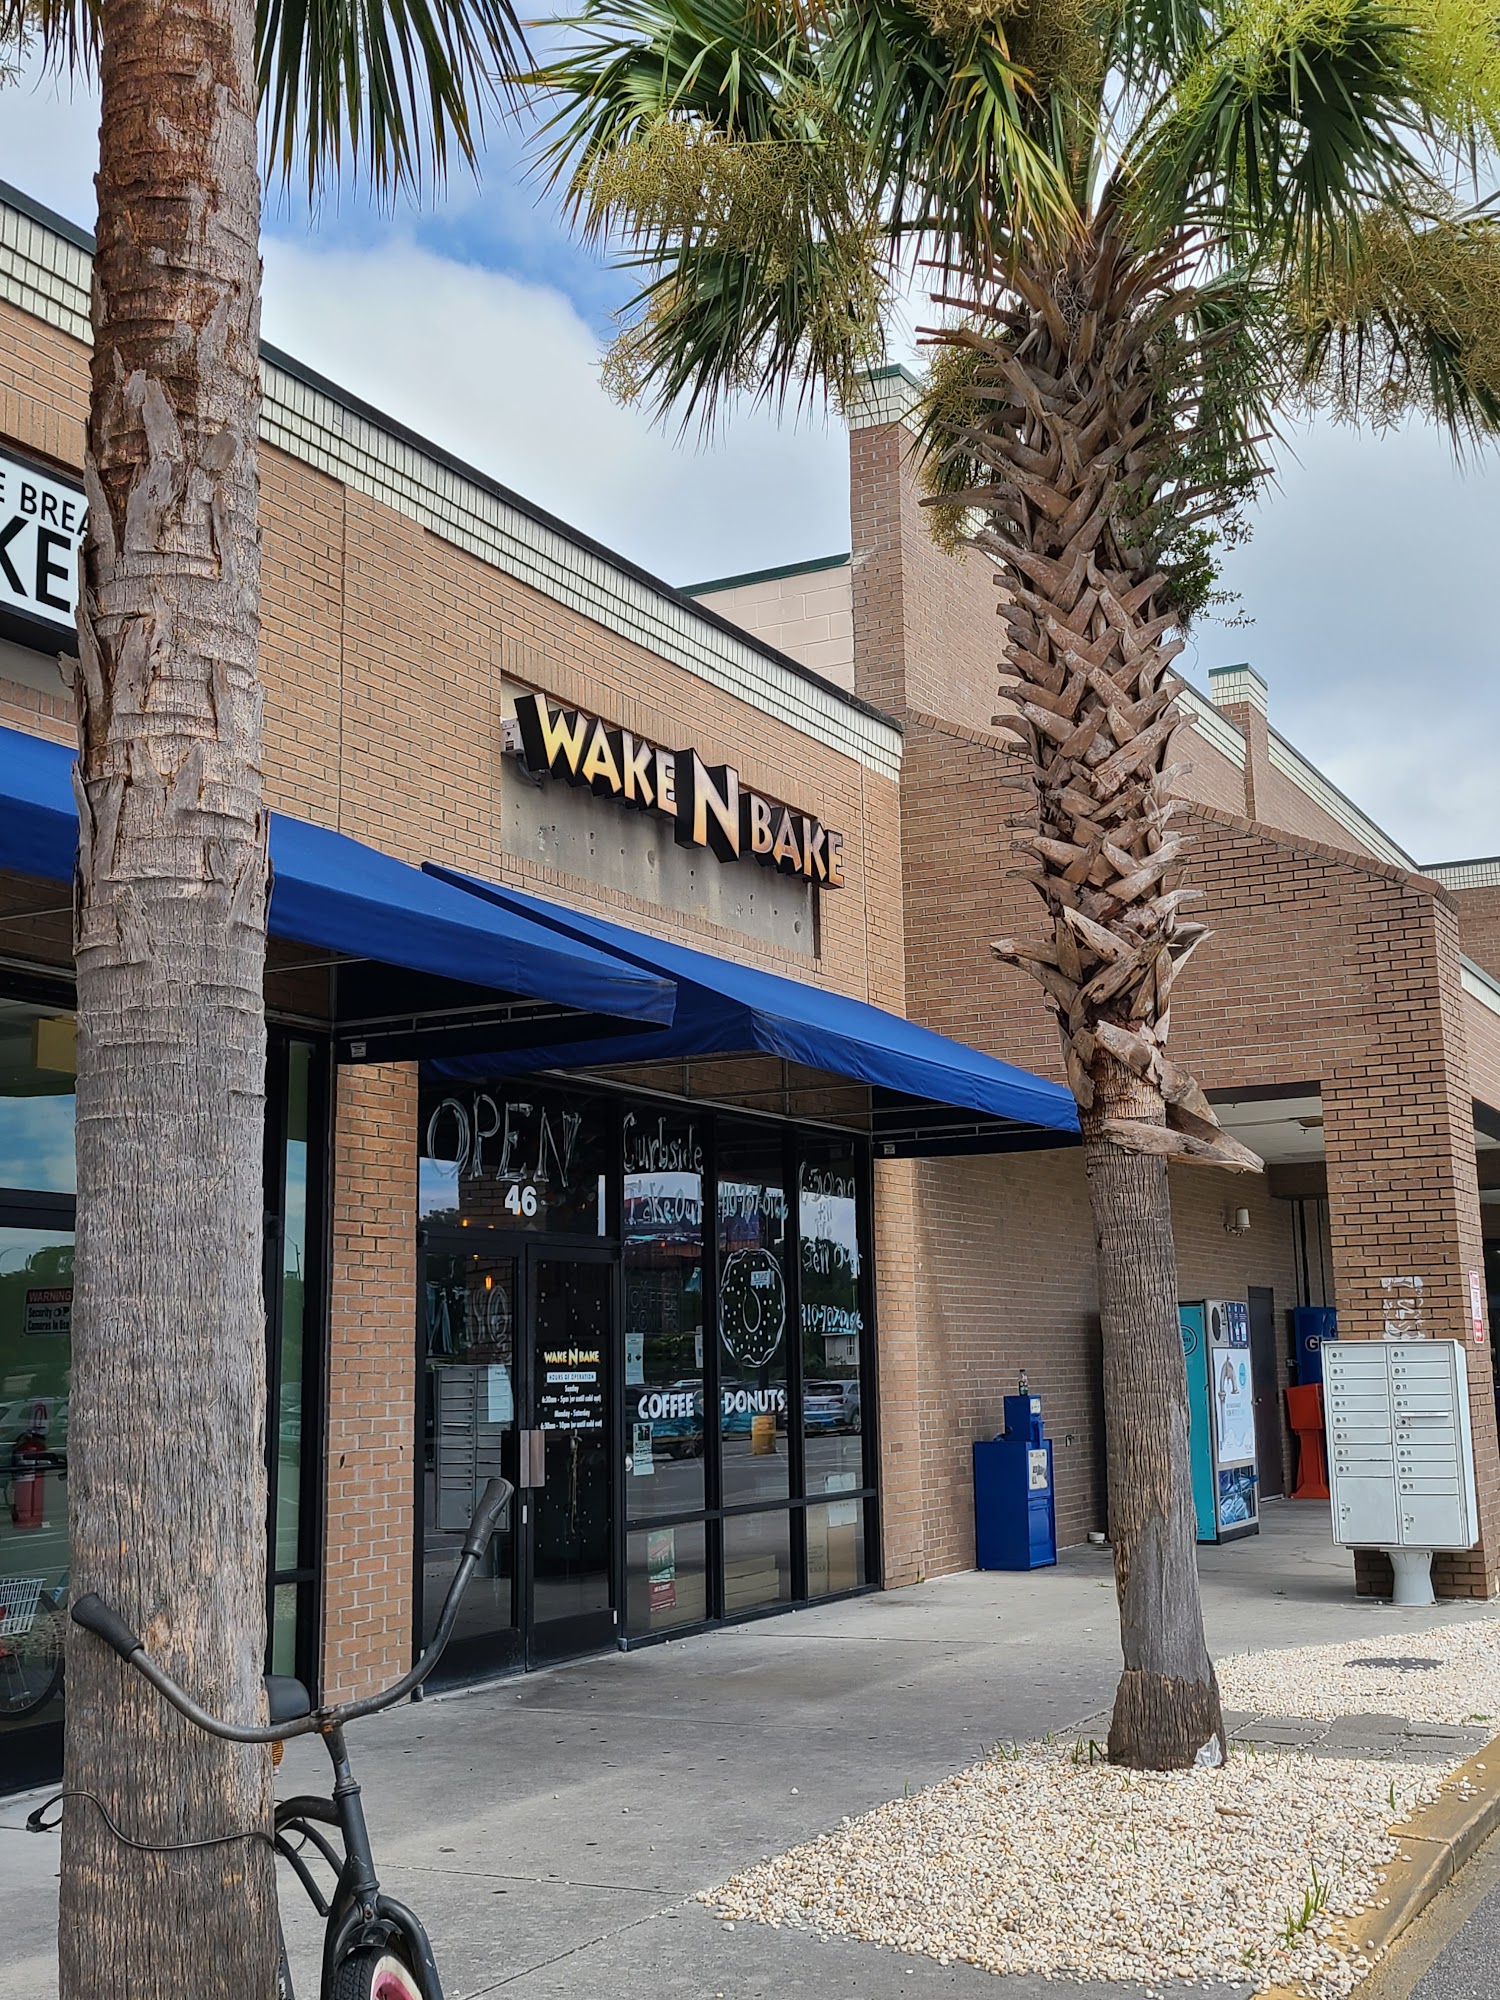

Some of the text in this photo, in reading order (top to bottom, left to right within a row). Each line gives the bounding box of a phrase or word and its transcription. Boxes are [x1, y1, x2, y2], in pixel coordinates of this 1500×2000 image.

[516, 693, 845, 889] WAKE N BAKE
[427, 1090, 582, 1187] OPEN
[623, 1111, 704, 1175] Curbside
[505, 1184, 537, 1217] 46
[28, 1290, 72, 1303] WARNING
[28, 1306, 53, 1320] Security
[28, 1320, 51, 1331] Cameras
[544, 1347, 600, 1367] WAKE N BAKE
[638, 1393, 695, 1420] COFFEE
[724, 1388, 786, 1416] DONUTS
